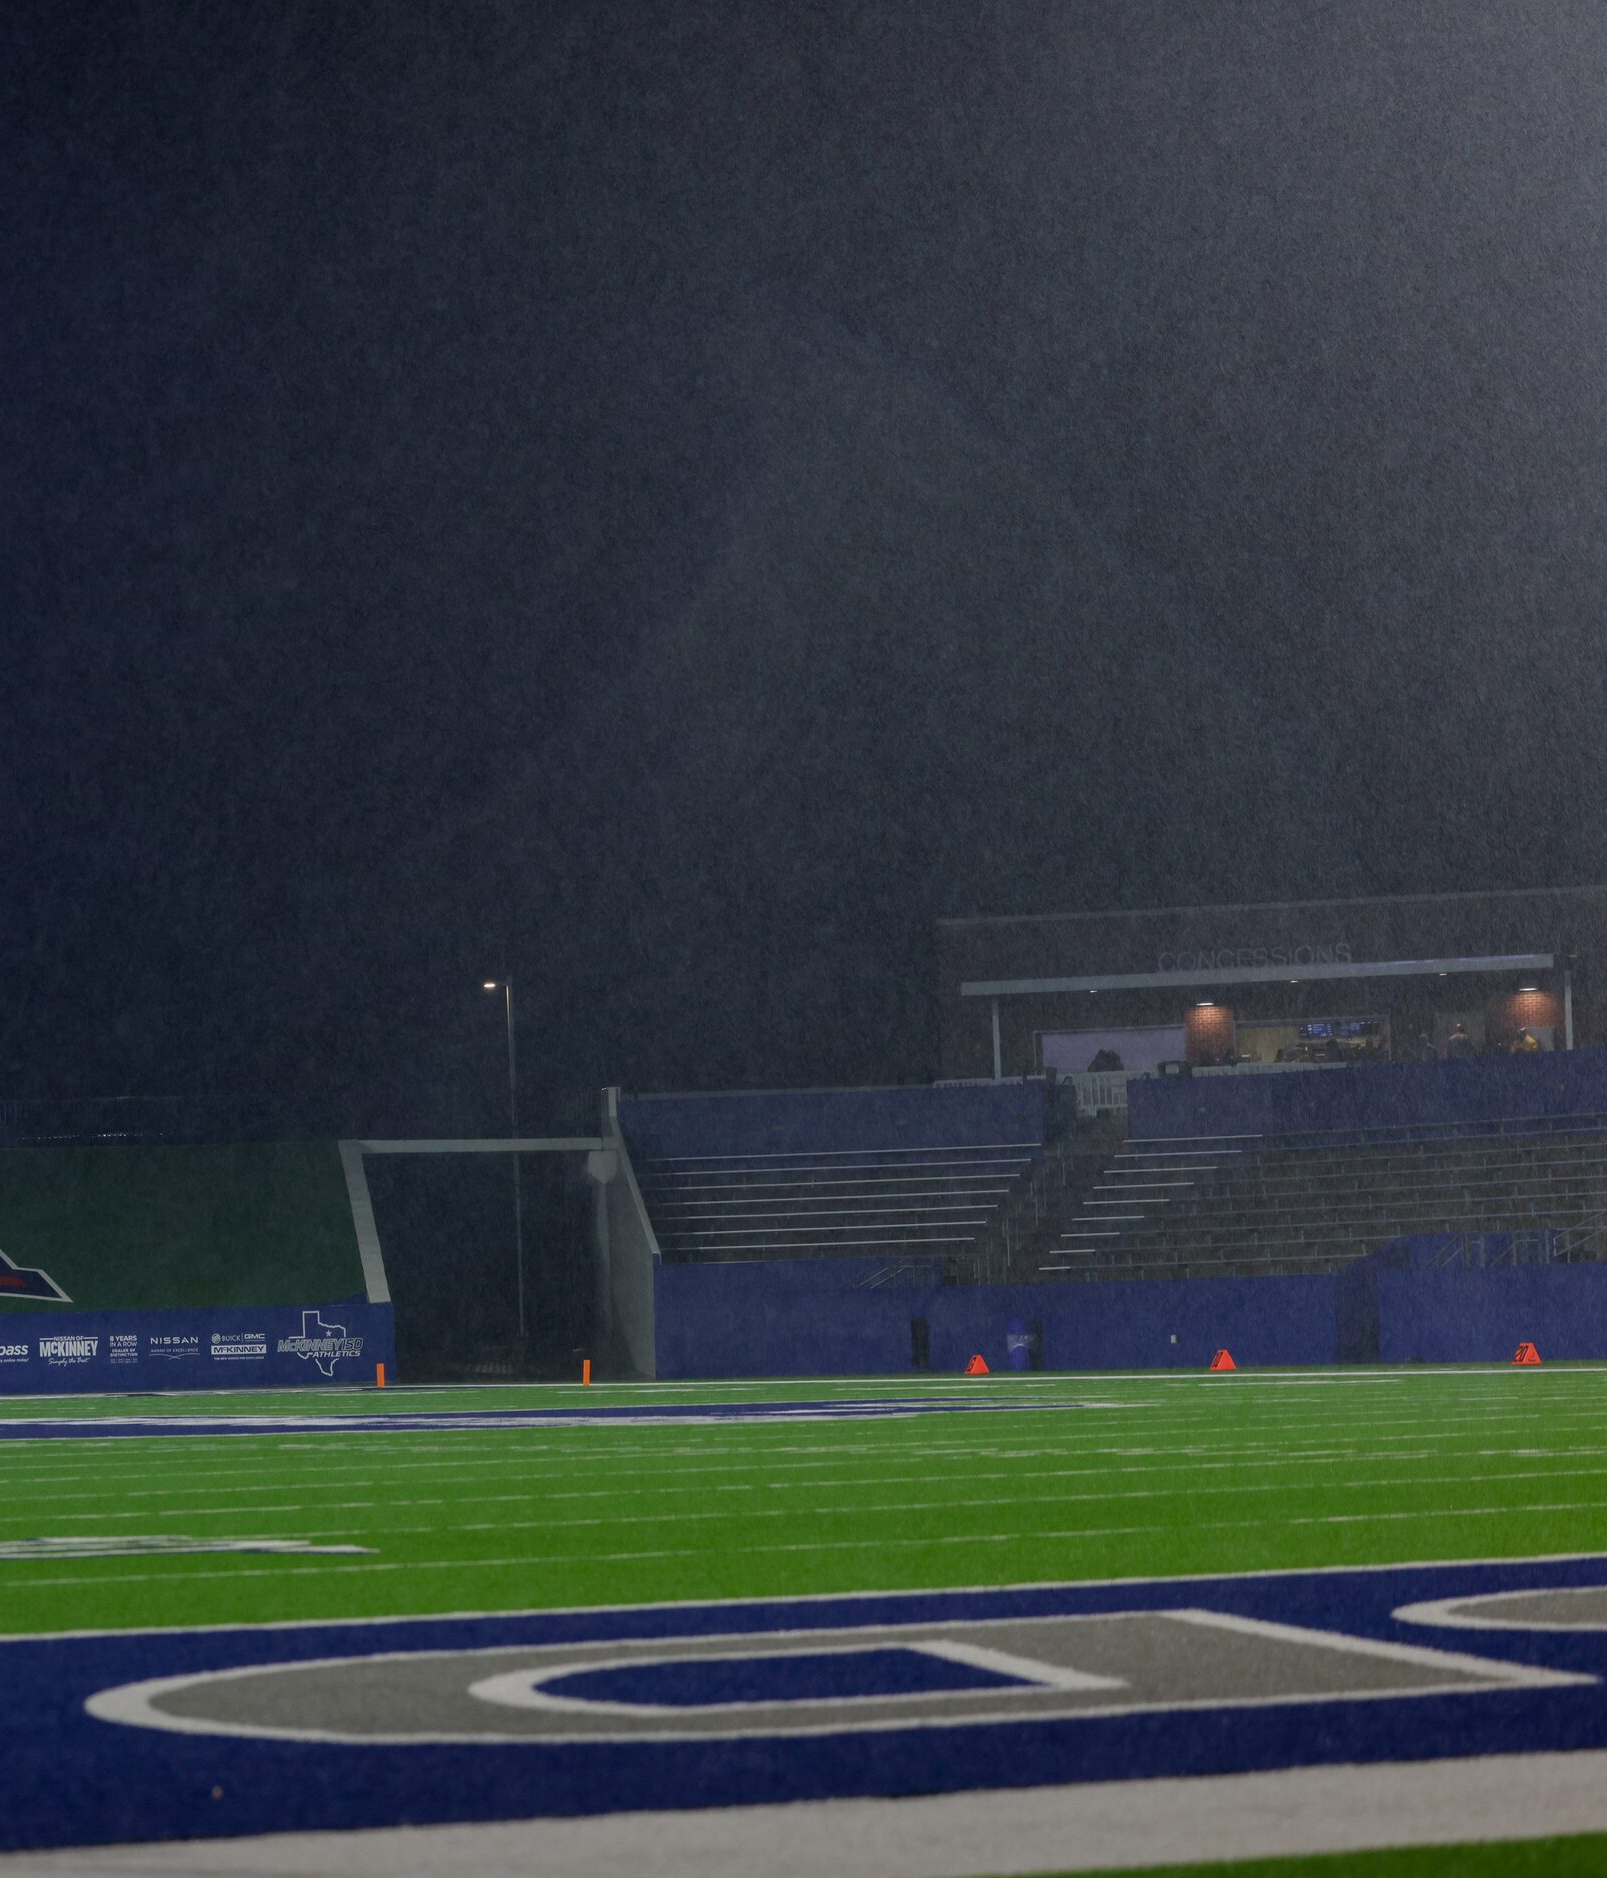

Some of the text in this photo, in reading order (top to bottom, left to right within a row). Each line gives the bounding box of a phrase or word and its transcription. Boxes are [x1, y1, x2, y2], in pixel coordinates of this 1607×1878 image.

[1158, 942, 1352, 972] CONCESSIONS
[150, 1336, 199, 1344] NISSAN
[221, 1334, 241, 1342] BUICK
[311, 1349, 361, 1358] ATHLETICS
